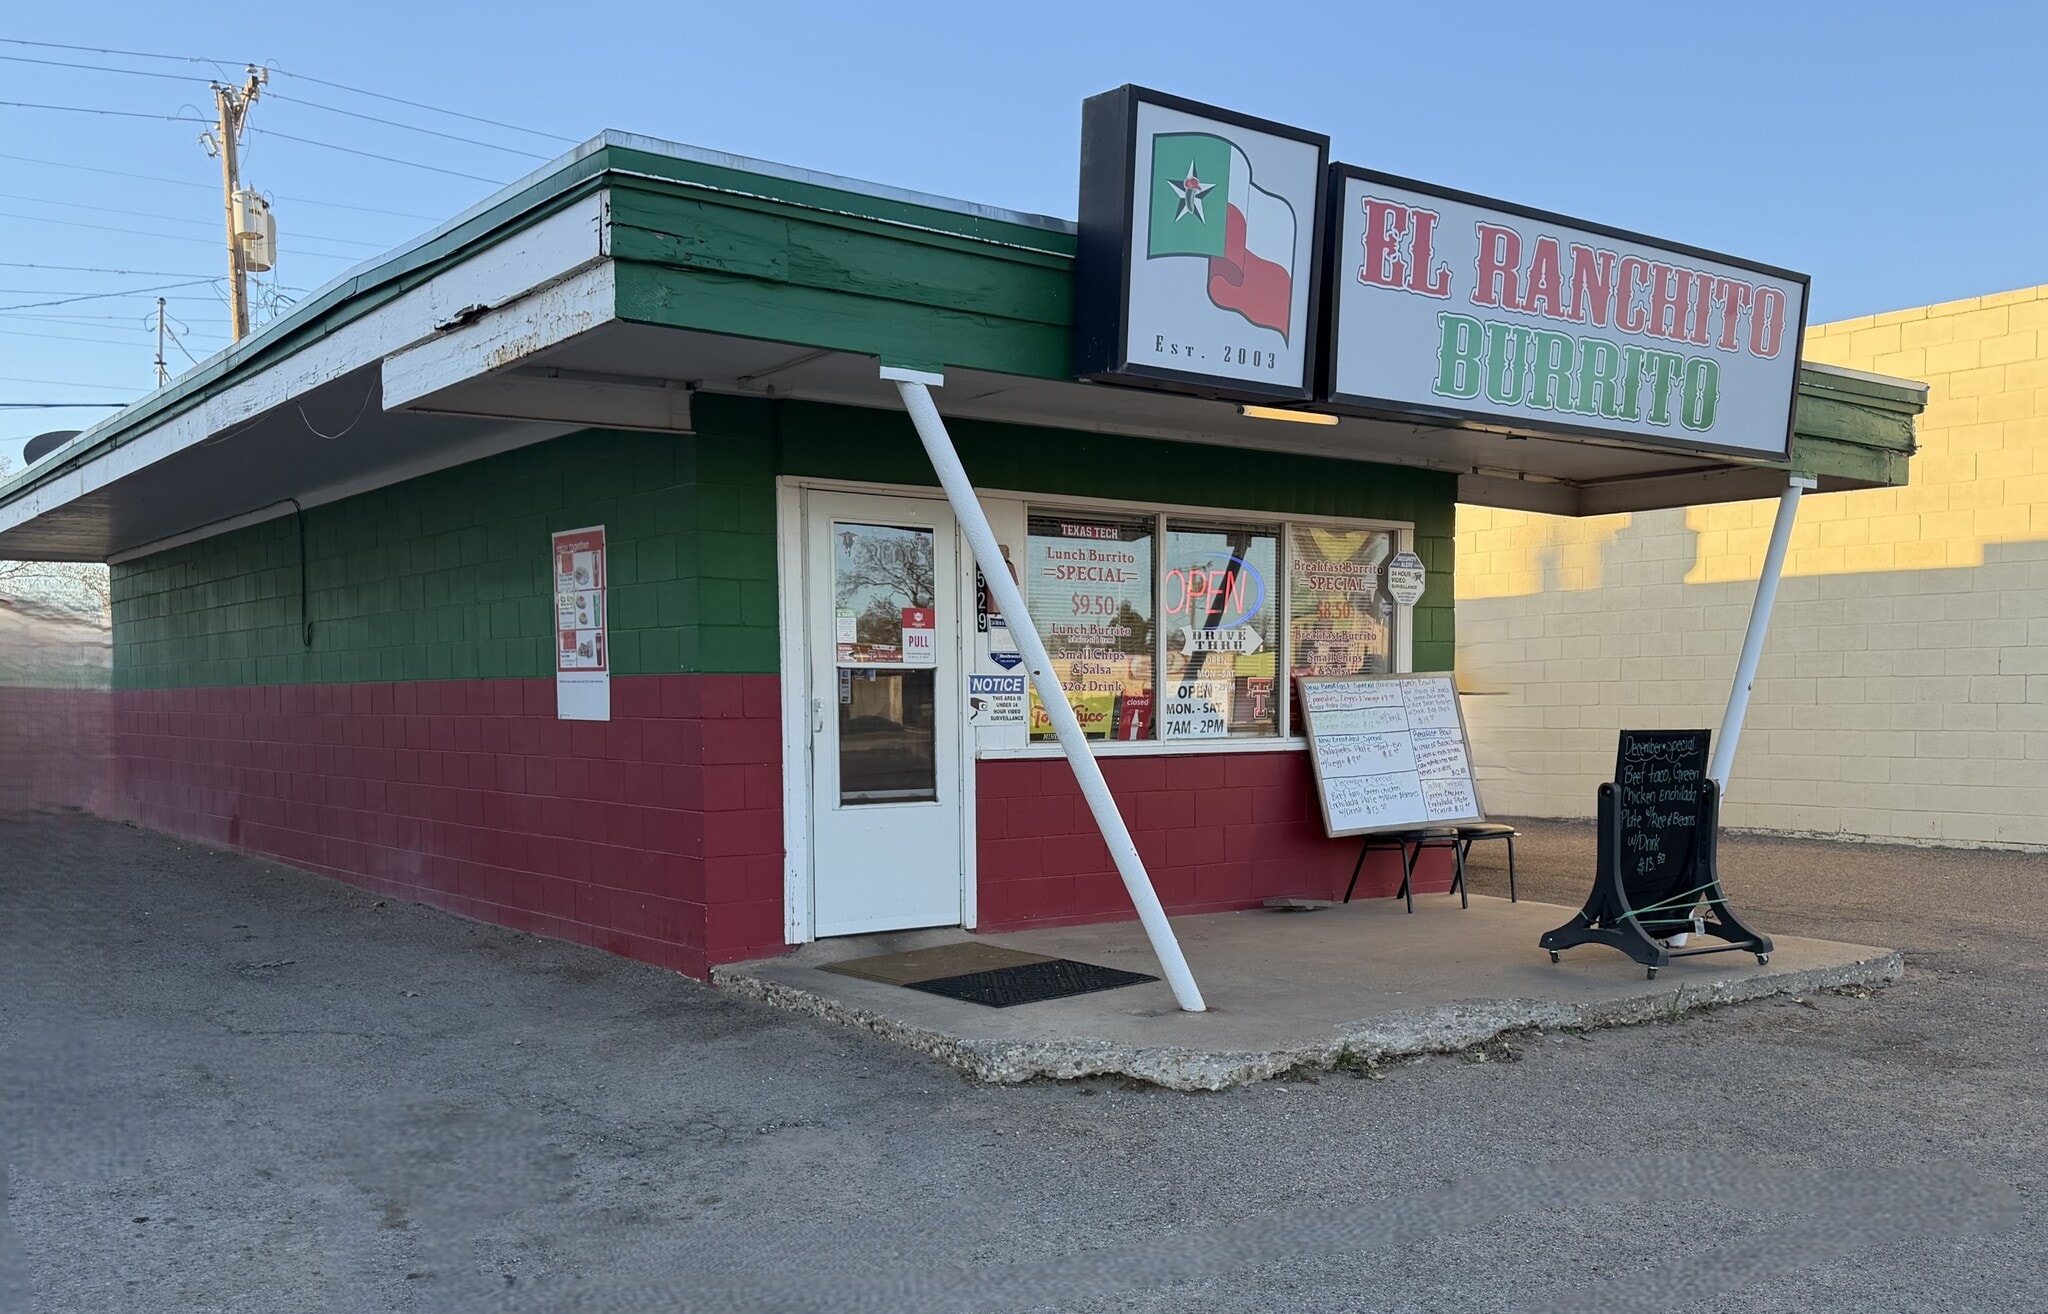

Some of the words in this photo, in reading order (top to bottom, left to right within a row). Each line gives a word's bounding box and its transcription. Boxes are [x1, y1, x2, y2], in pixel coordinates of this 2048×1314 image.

[1358, 195, 1453, 299] EL
[1470, 221, 1788, 360] RANCHITO
[1223, 345, 1276, 369] 2003
[1432, 311, 1721, 432] BURRITO
[1061, 523, 1093, 537] TEXAS
[1094, 527, 1119, 540] TECH
[1046, 546, 1086, 561] Lunch
[1088, 549, 1135, 564] Burrito
[1056, 564, 1126, 583] SPECIAL
[1294, 559, 1343, 574] Breakfast
[1345, 562, 1384, 575] Burrito
[1164, 569, 1248, 615] OPEN
[1309, 575, 1366, 592] SPECIAL
[1071, 591, 1115, 616] $9.50
[1316, 600, 1351, 621] $8.50
[1051, 622, 1087, 635] Lunch
[1089, 624, 1131, 637] Burrito
[1191, 630, 1247, 641] DRIVE
[1295, 629, 1341, 641] Breakfast
[1341, 630, 1377, 641] Burrito
[908, 635, 929, 648] PULL
[1195, 641, 1243, 651] THRU
[1059, 647, 1091, 660] Small
[1093, 648, 1125, 662] Chips
[1071, 663, 1081, 674] &
[1082, 664, 1112, 675] Salsa
[972, 678, 1022, 692] NOTICE
[1089, 680, 1122, 692] Drink
[1177, 685, 1213, 699] OPEN
[1127, 698, 1149, 706] closed
[1166, 703, 1195, 715] MON.
[1203, 701, 1225, 714] SAT.
[1166, 721, 1192, 736] 7AM
[1199, 719, 1225, 734] 2PM
[1624, 736, 1663, 757] December
[1666, 736, 1697, 760] Special
[1624, 762, 1647, 785] Beef
[1673, 762, 1700, 784] Green
[1622, 786, 1656, 807] Chicken
[1659, 783, 1697, 804] Enchilada
[1620, 808, 1643, 829] Plate
